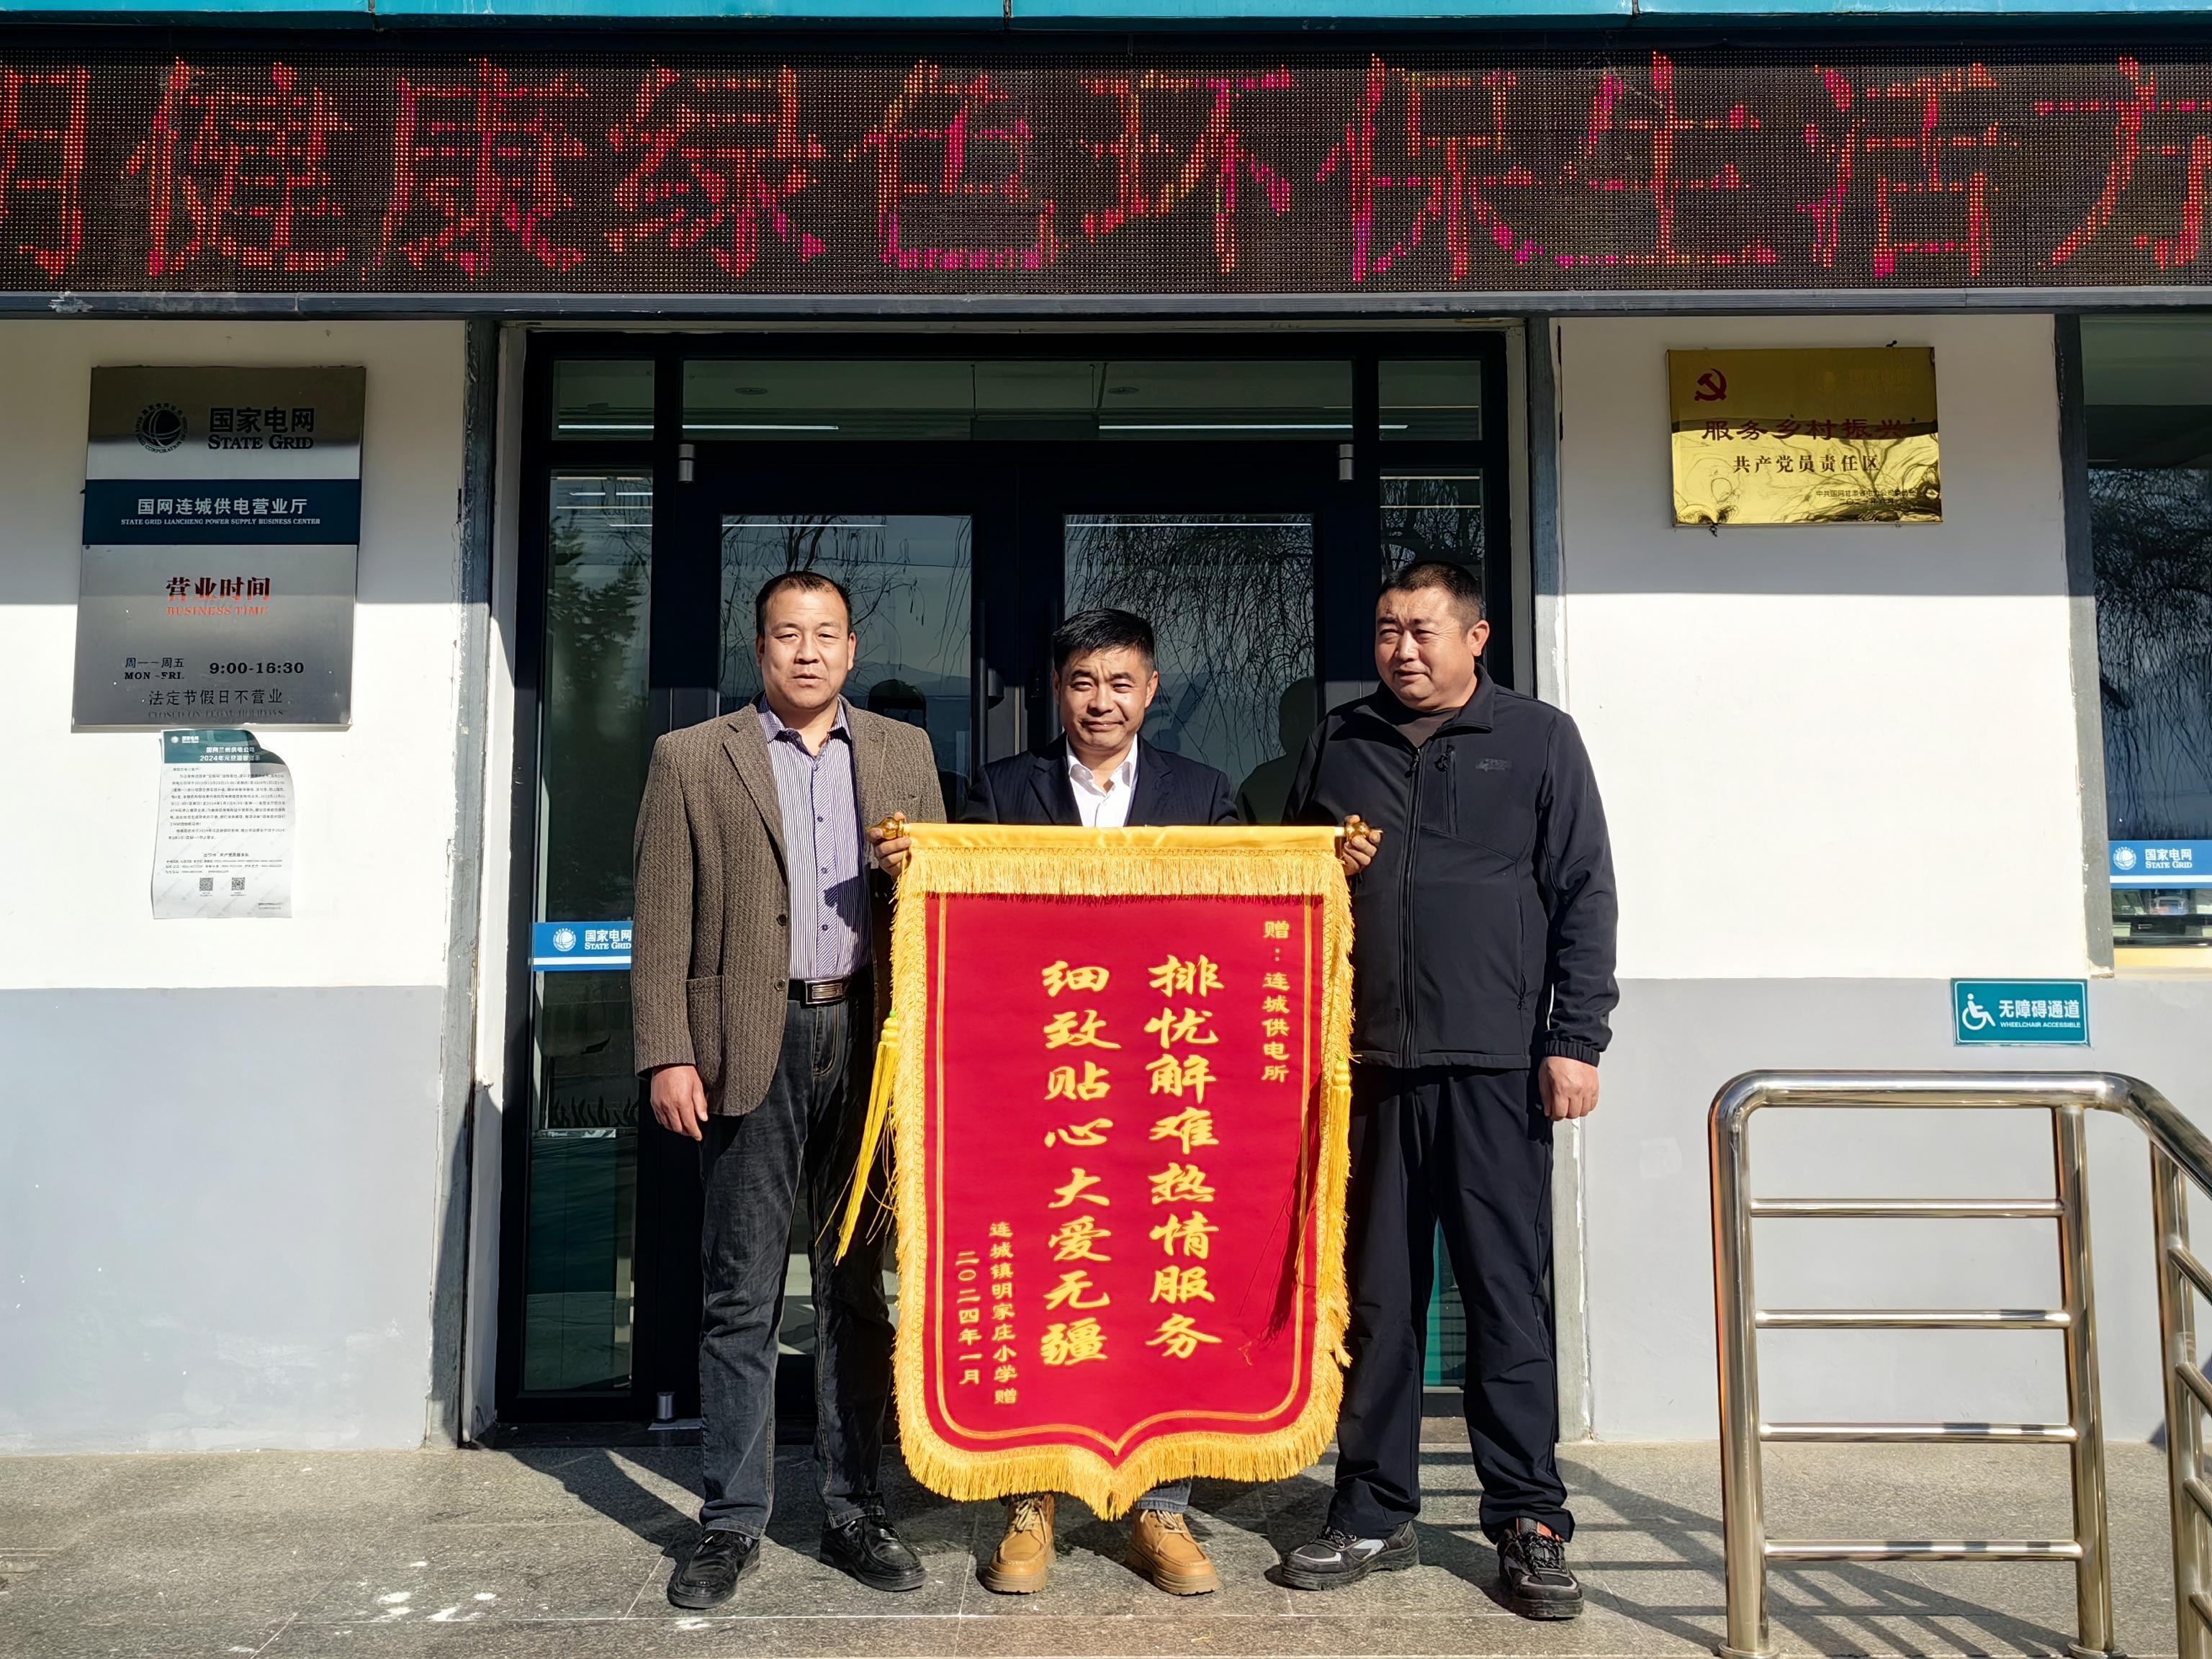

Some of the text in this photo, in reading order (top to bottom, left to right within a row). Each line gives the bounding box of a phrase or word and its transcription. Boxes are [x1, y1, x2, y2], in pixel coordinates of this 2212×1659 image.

[209, 407, 315, 433] 国家电网
[1701, 414, 1902, 441] 服务乡村振兴
[207, 434, 315, 450] STATE GRID
[1732, 454, 1881, 474] 共产党员责任区
[138, 498, 307, 515] 国网连城供电营业厅
[166, 576, 271, 601] 营业时间
[210, 662, 304, 674] 9:00-16:30
[148, 688, 282, 706] 法定节假日不营业
[2144, 848, 2192, 860] 国家电网
[585, 929, 631, 942] 国家电网
[1999, 999, 2080, 1018] 无障碍通道
[1040, 960, 1121, 1366] 细致贴心大爱无疆
[1143, 954, 1224, 1359] 排忧解难热情服务
[956, 1251, 982, 1385] 二〇二四年一月
[989, 1221, 1017, 1404] 连城镇明家庄小学赠
